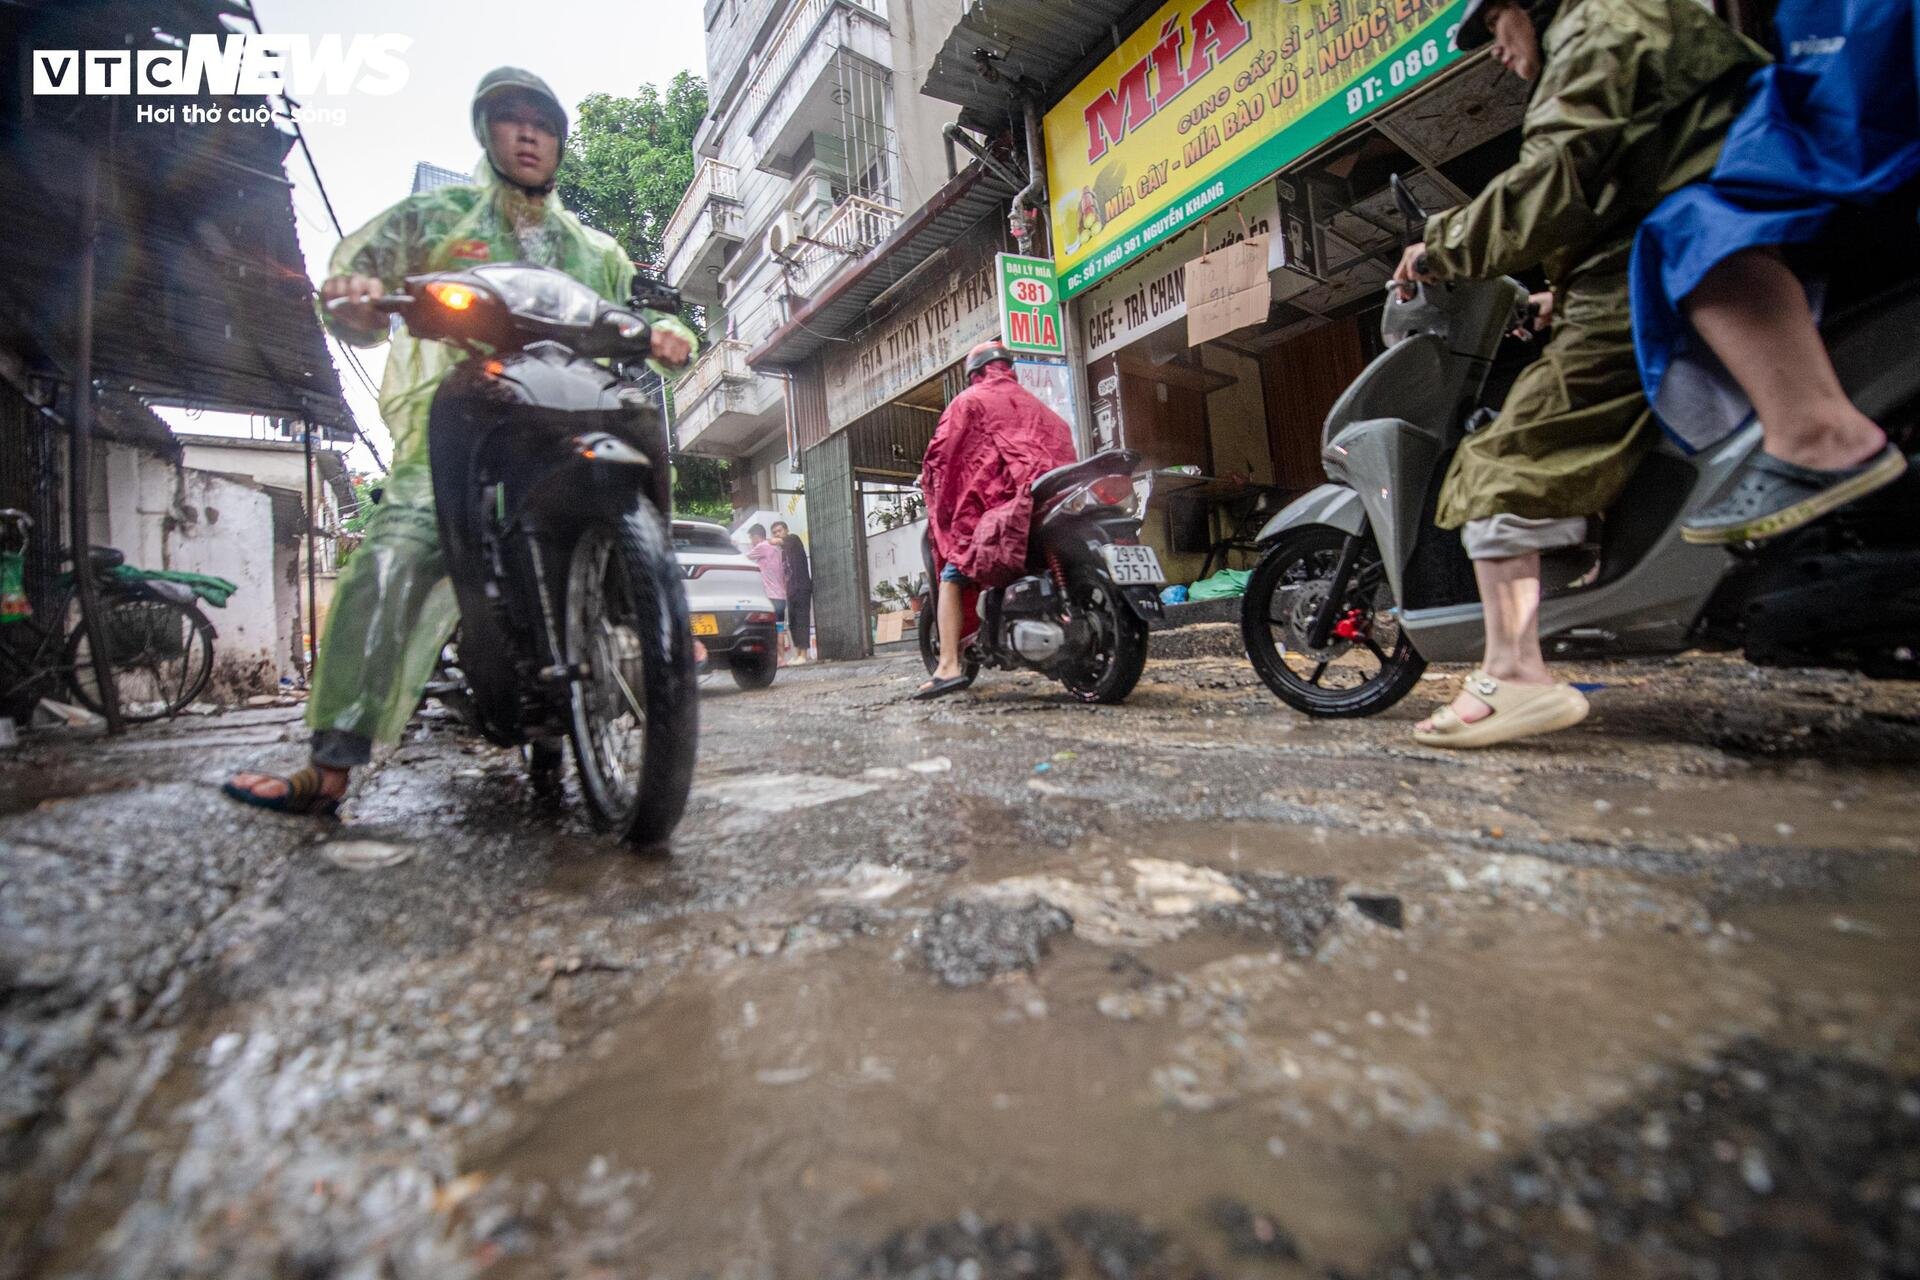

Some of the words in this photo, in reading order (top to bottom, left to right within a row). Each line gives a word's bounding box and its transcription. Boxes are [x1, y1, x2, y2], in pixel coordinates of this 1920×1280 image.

[1084, 0, 1252, 165] MÍA
[1104, 185, 1136, 224] MÍA
[1183, 125, 1221, 168] MÍA
[1223, 93, 1264, 141] BÀO
[1267, 63, 1298, 108] VỎ
[1318, 7, 1388, 75] NƯỚC
[1177, 86, 1231, 134] CUNG
[1234, 49, 1277, 92] CẤP
[1346, 76, 1383, 115] ĐT:
[1388, 39, 1439, 87] 086
[1095, 258, 1102, 272] 7
[1124, 234, 1141, 255] 381
[1185, 181, 1225, 217] KHANG
[1010, 307, 1058, 346] MÍA
[1017, 281, 1045, 303] 381
[1089, 300, 1116, 350] CAFÉ
[1124, 282, 1148, 331] TRÀ
[1150, 266, 1186, 317] CHAN
